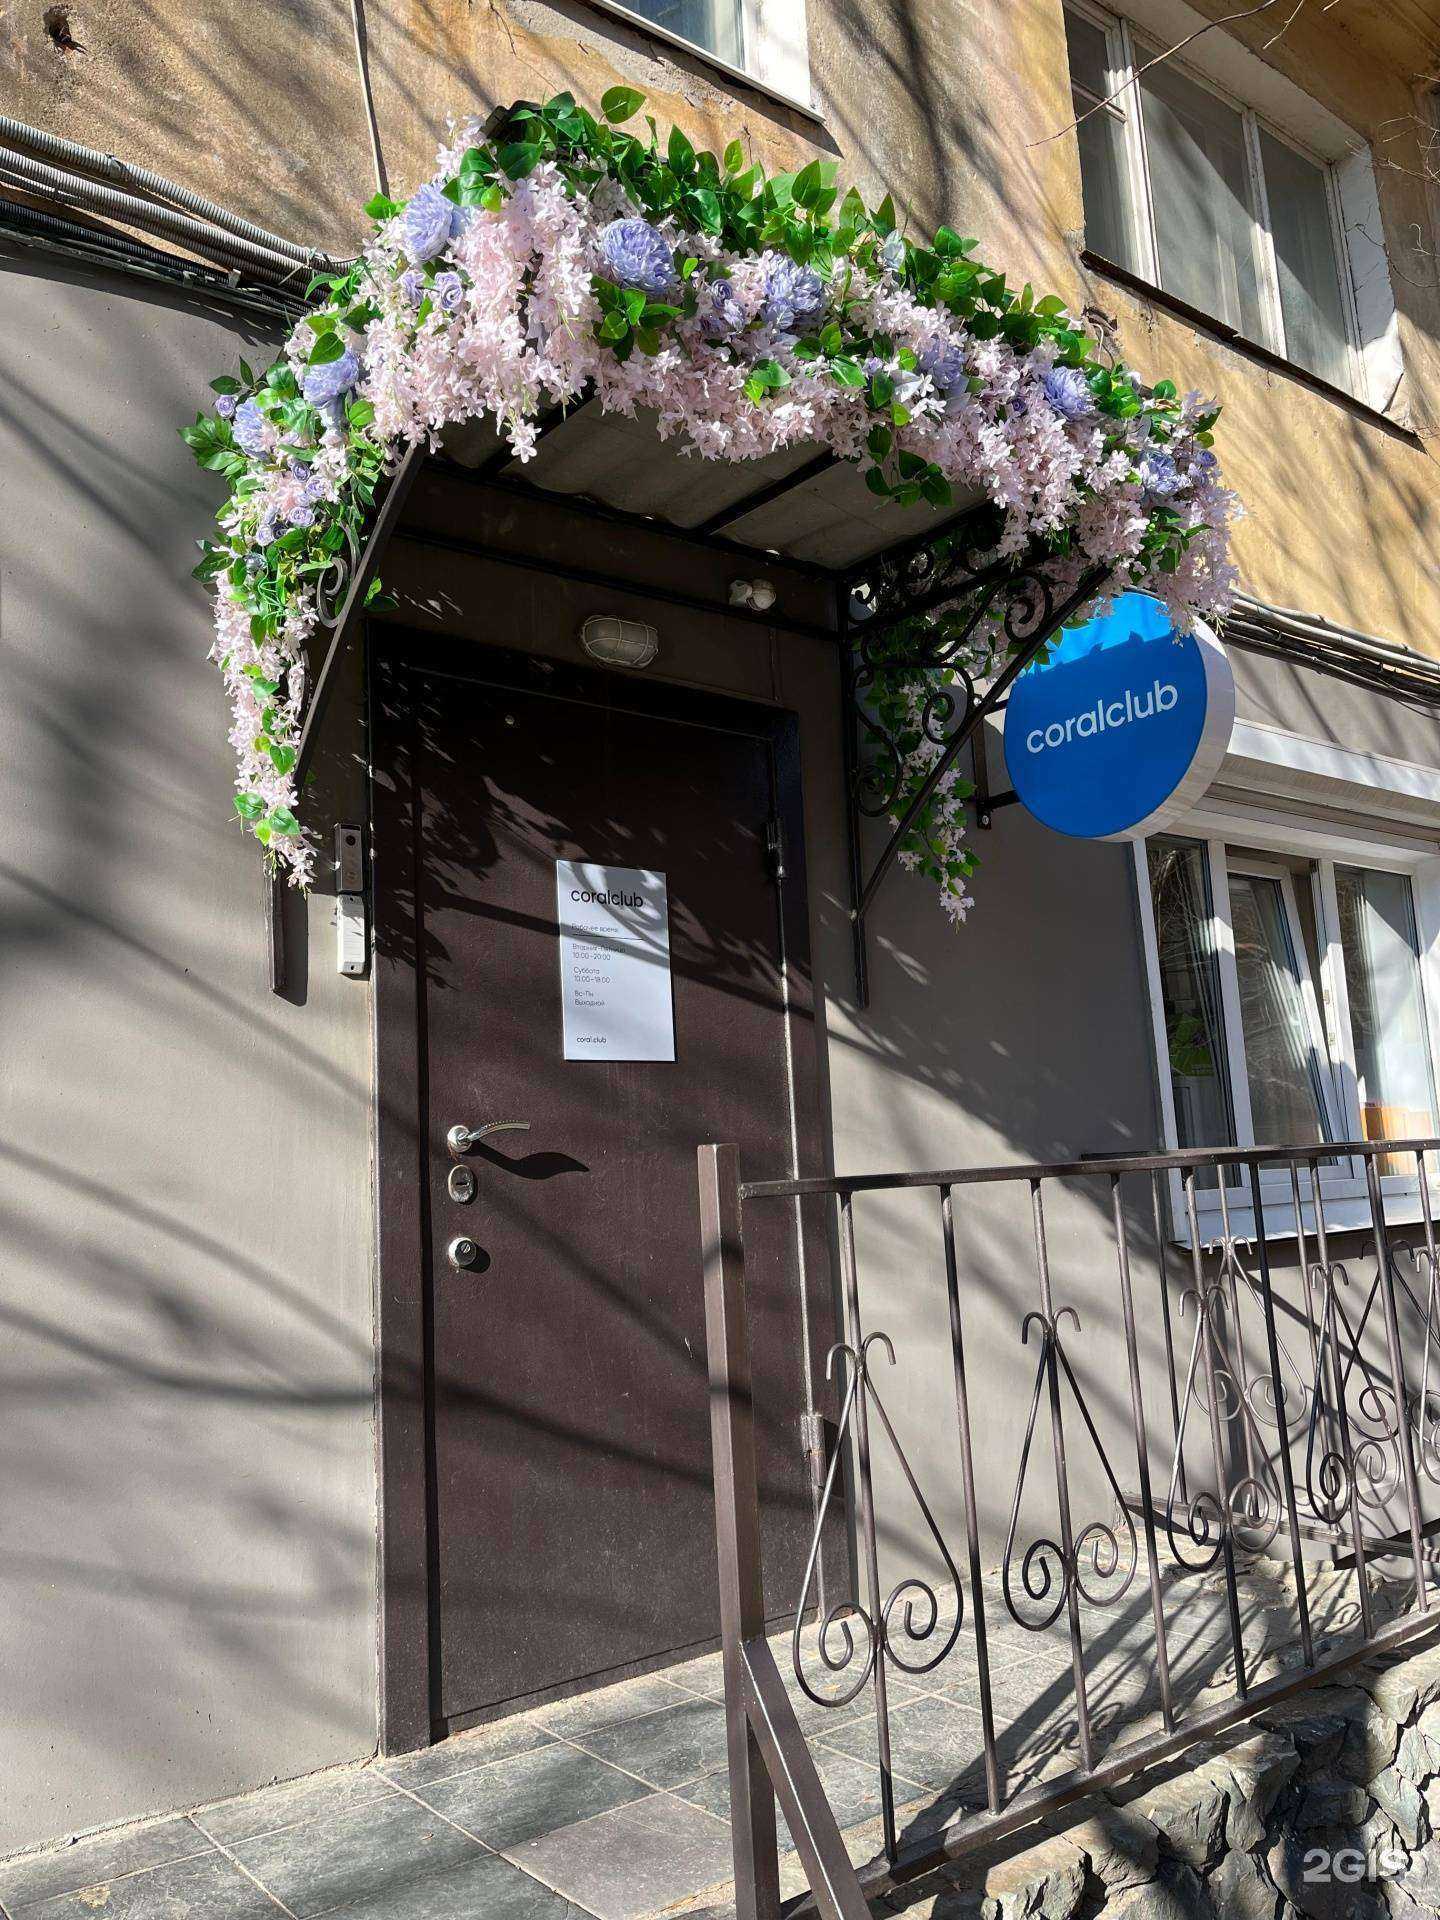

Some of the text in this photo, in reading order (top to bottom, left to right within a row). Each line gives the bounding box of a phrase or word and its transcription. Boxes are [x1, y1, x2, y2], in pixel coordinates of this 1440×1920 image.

[1026, 680, 1178, 754] coralclub
[570, 889, 644, 908] coralclub
[573, 966, 600, 975] Суббота
